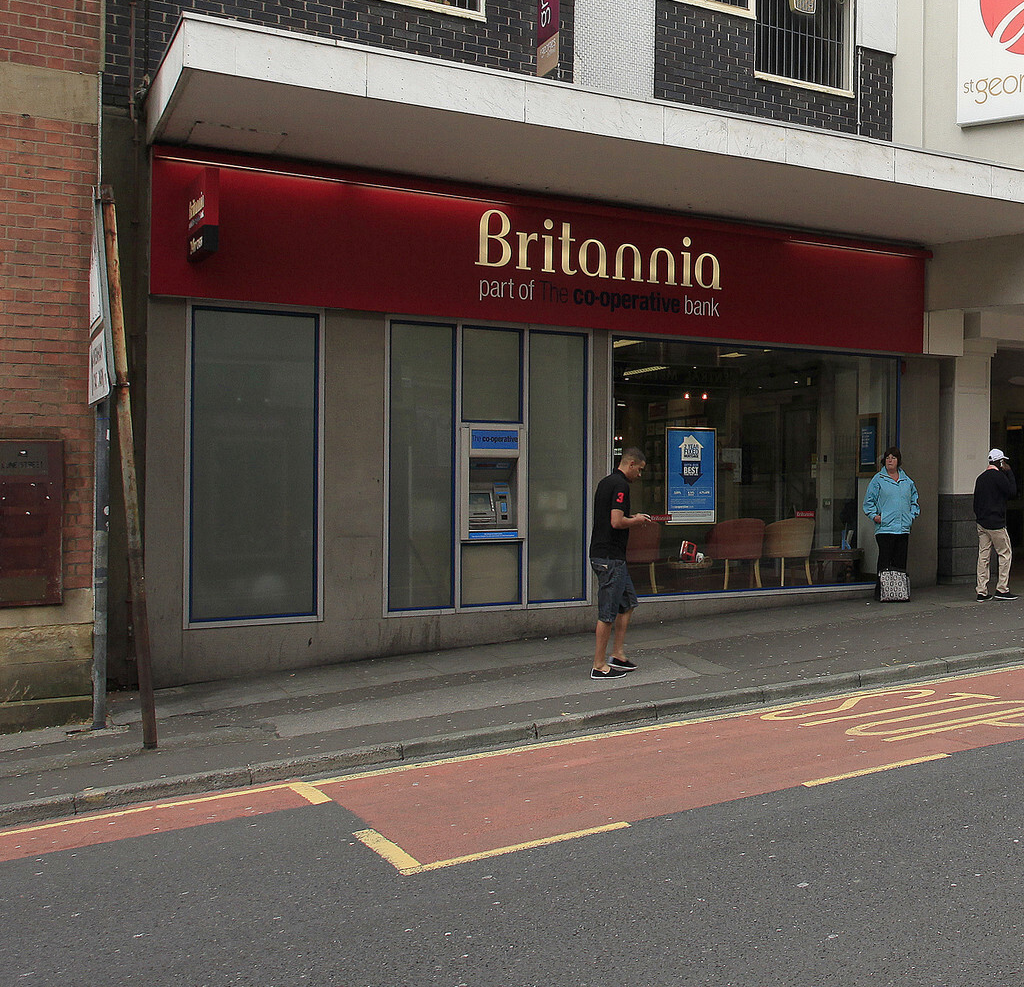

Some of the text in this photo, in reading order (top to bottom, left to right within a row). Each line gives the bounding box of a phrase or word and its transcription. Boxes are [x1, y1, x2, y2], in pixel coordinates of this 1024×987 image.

[963, 79, 975, 94] st
[474, 209, 722, 290] Britannia
[479, 278, 720, 317] part of The co-operative bank
[482, 434, 519, 443] co-operative
[683, 467, 699, 475] BEST
[616, 492, 624, 503] 3
